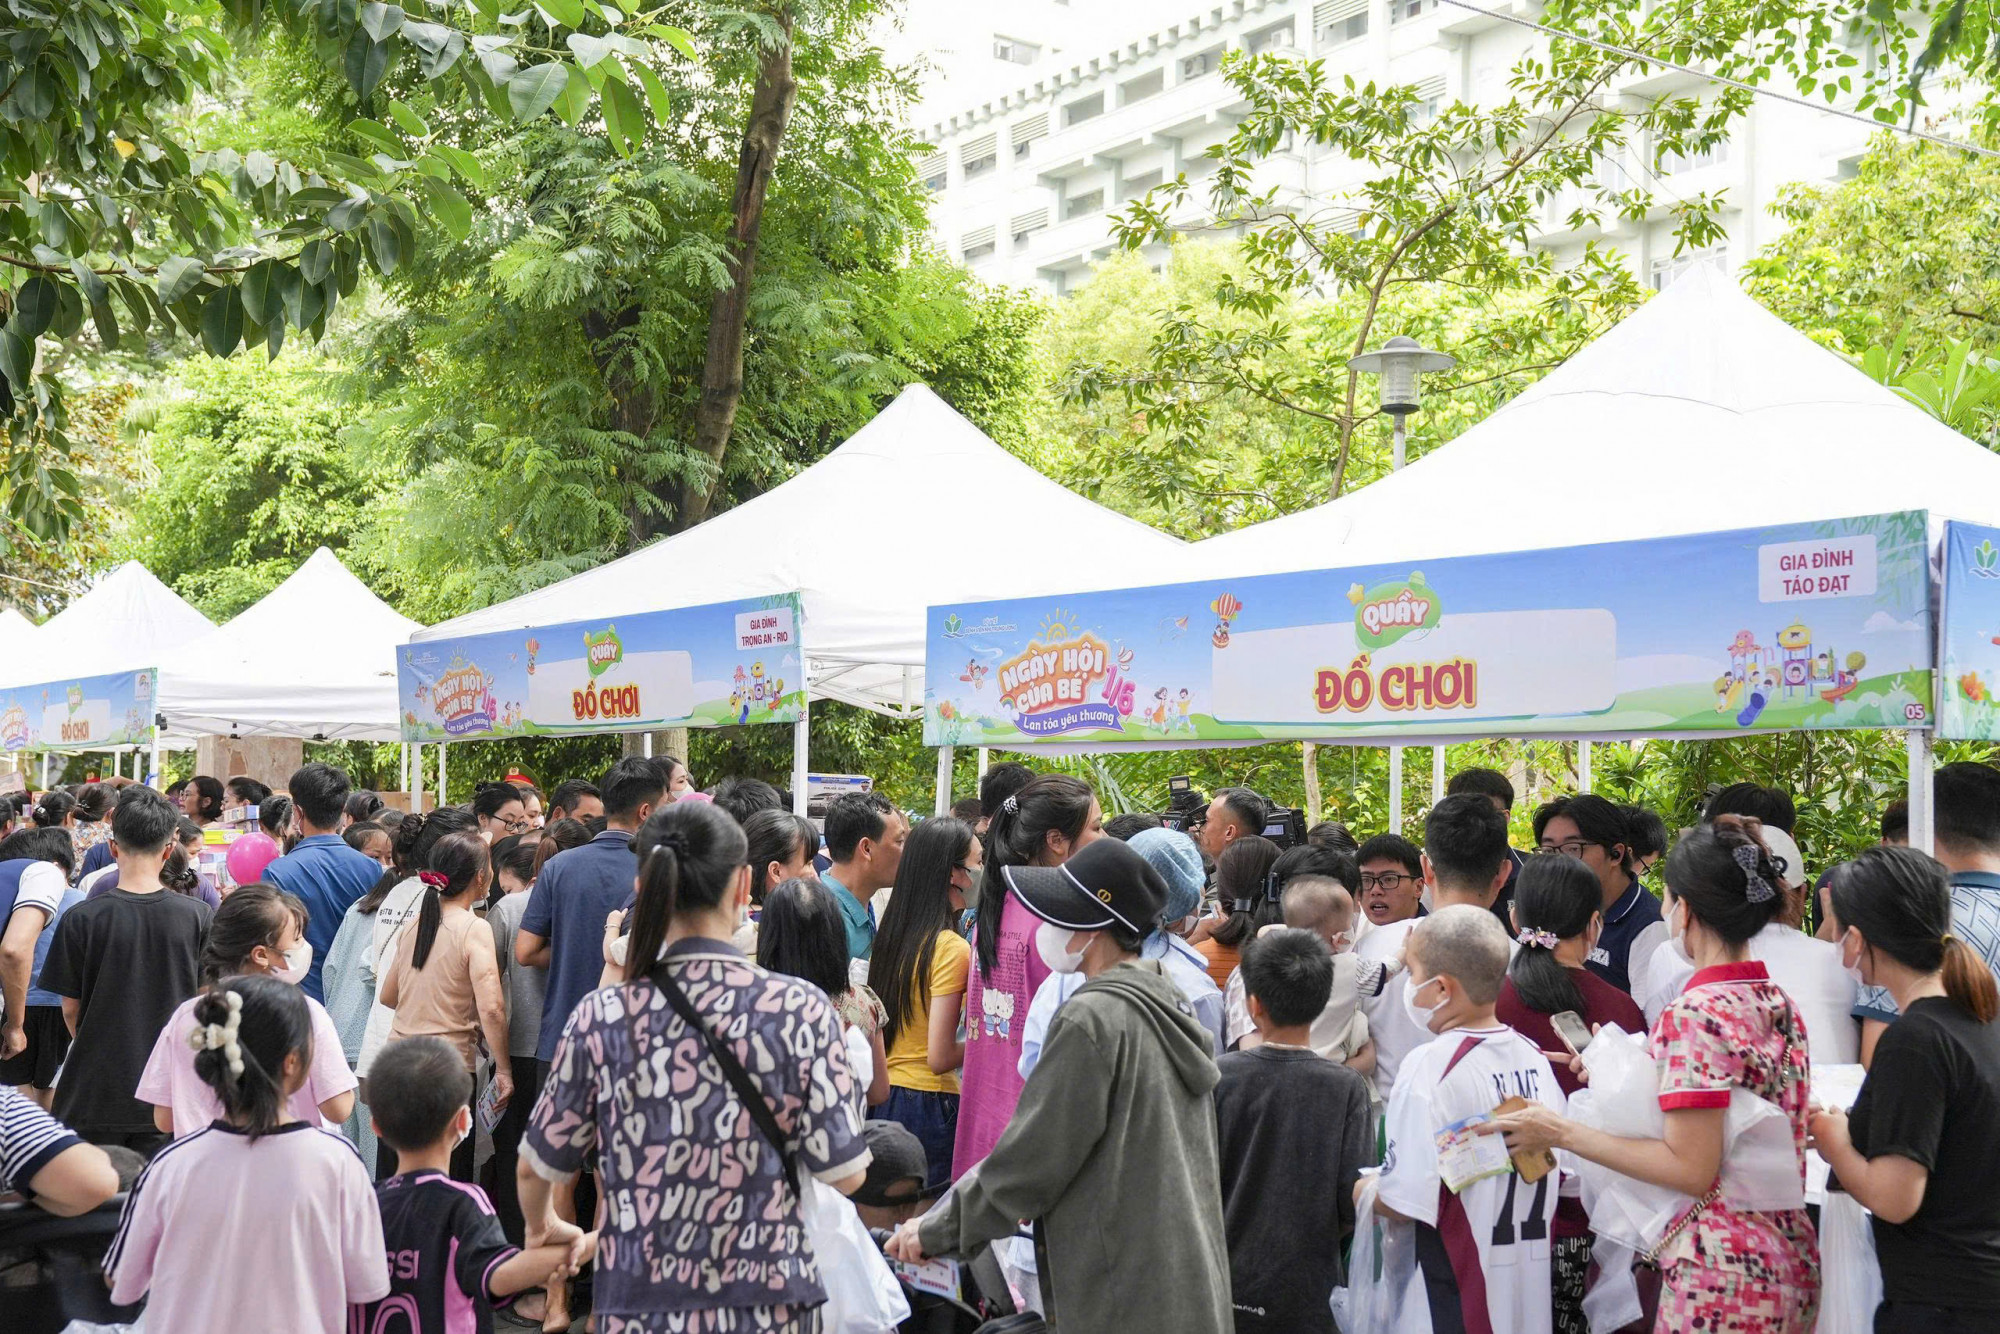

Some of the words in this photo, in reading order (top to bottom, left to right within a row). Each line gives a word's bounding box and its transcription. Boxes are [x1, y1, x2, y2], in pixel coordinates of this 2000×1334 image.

[1780, 555, 1808, 571] GIA
[1812, 547, 1853, 569] ĐÌNH
[1783, 574, 1814, 595] TÁO
[1818, 574, 1850, 595] ĐẠT
[750, 619, 761, 630] GIA
[761, 615, 778, 629] ĐÌNH
[1362, 588, 1430, 635] QUẦY
[590, 636, 618, 667] QUẦY
[741, 634, 763, 648] TRỌNG
[763, 634, 772, 644] AN
[1001, 649, 1058, 693] NGÀY
[1062, 641, 1104, 680] HỘI
[434, 674, 461, 704] NGÀY
[462, 670, 481, 695] HỘI
[1016, 681, 1054, 713] CỦA
[1057, 671, 1083, 700] BÉ
[1101, 663, 1136, 716] 1/6
[1313, 654, 1372, 710] ĐỒ
[1379, 659, 1475, 708] CHƠI
[442, 697, 460, 718] CỦA
[460, 690, 473, 710] BÉ
[481, 685, 497, 721] 1/6
[573, 680, 598, 718] ĐỒ
[600, 684, 640, 716] CHƠI
[1904, 703, 1926, 720] 05
[447, 722, 456, 731] Lan
[1023, 716, 1041, 731] Lan
[1043, 718, 1059, 731] tỏa
[1060, 714, 1078, 732] yêu
[1079, 709, 1115, 725] thương
[1162, 819, 1181, 831] VTV
